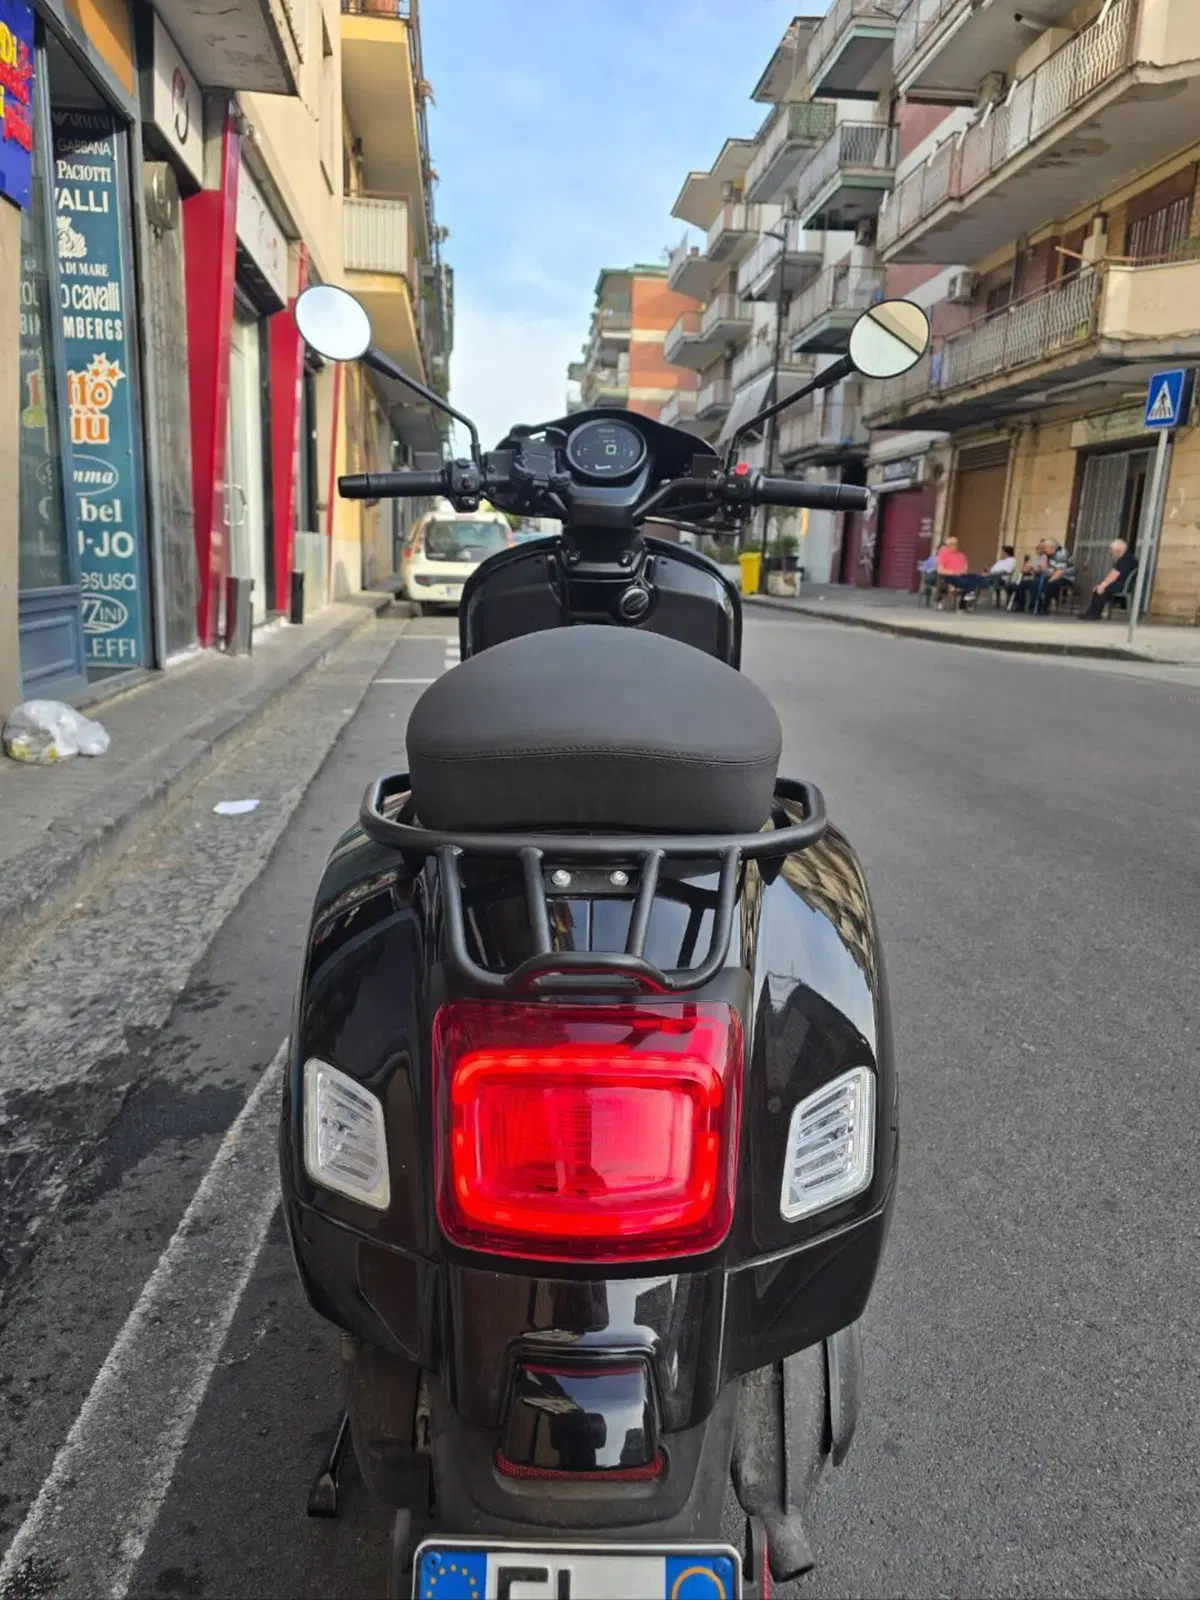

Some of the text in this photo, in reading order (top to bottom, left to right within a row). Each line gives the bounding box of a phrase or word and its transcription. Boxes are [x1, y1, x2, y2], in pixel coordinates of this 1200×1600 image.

[57, 139, 112, 156] GABBANA
[56, 160, 112, 183] PACIOTTI
[79, 262, 108, 277] MARE
